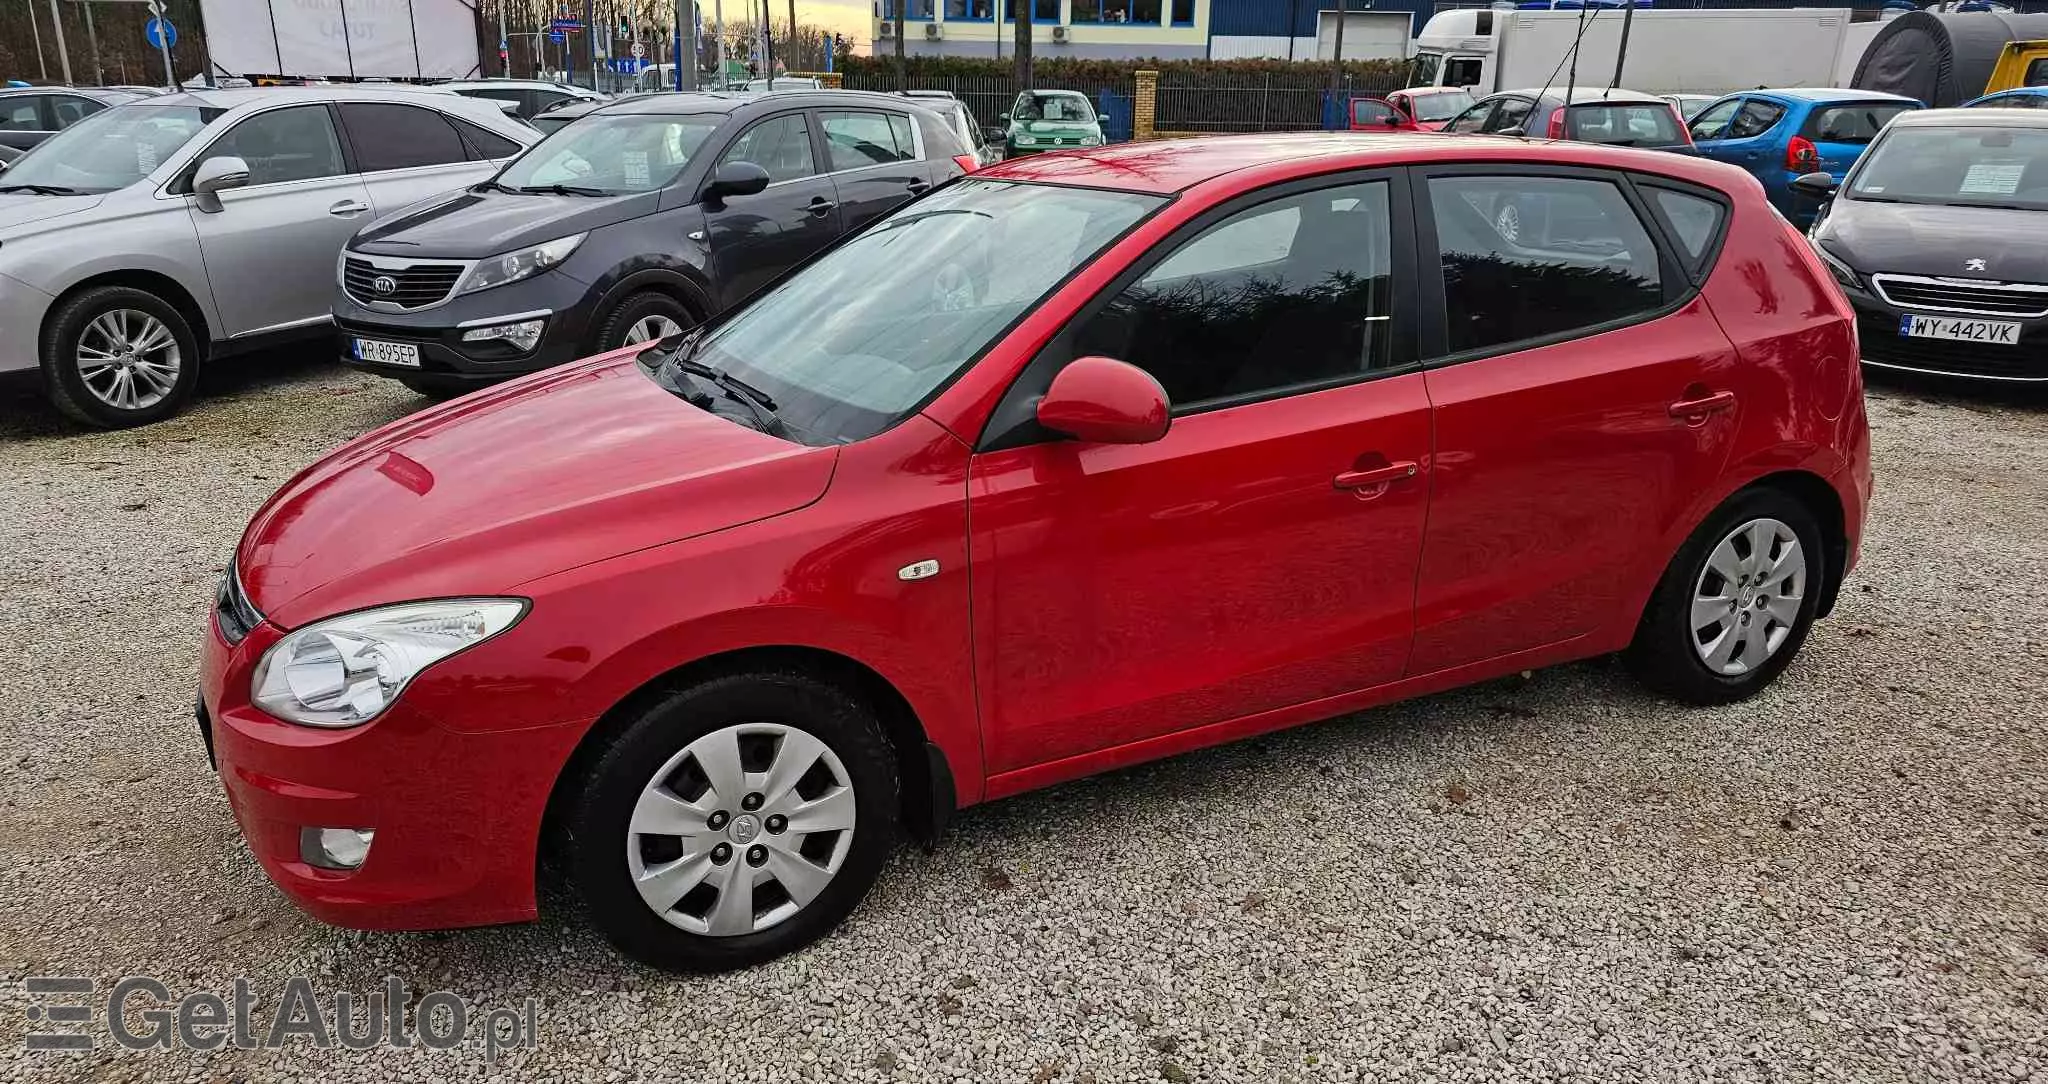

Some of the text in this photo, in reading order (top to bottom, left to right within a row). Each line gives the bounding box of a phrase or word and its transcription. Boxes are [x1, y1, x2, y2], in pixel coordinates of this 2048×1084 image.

[375, 280, 391, 292] KIA
[1914, 318, 2015, 342] WY 442VK
[361, 341, 415, 363] WR 895EP
